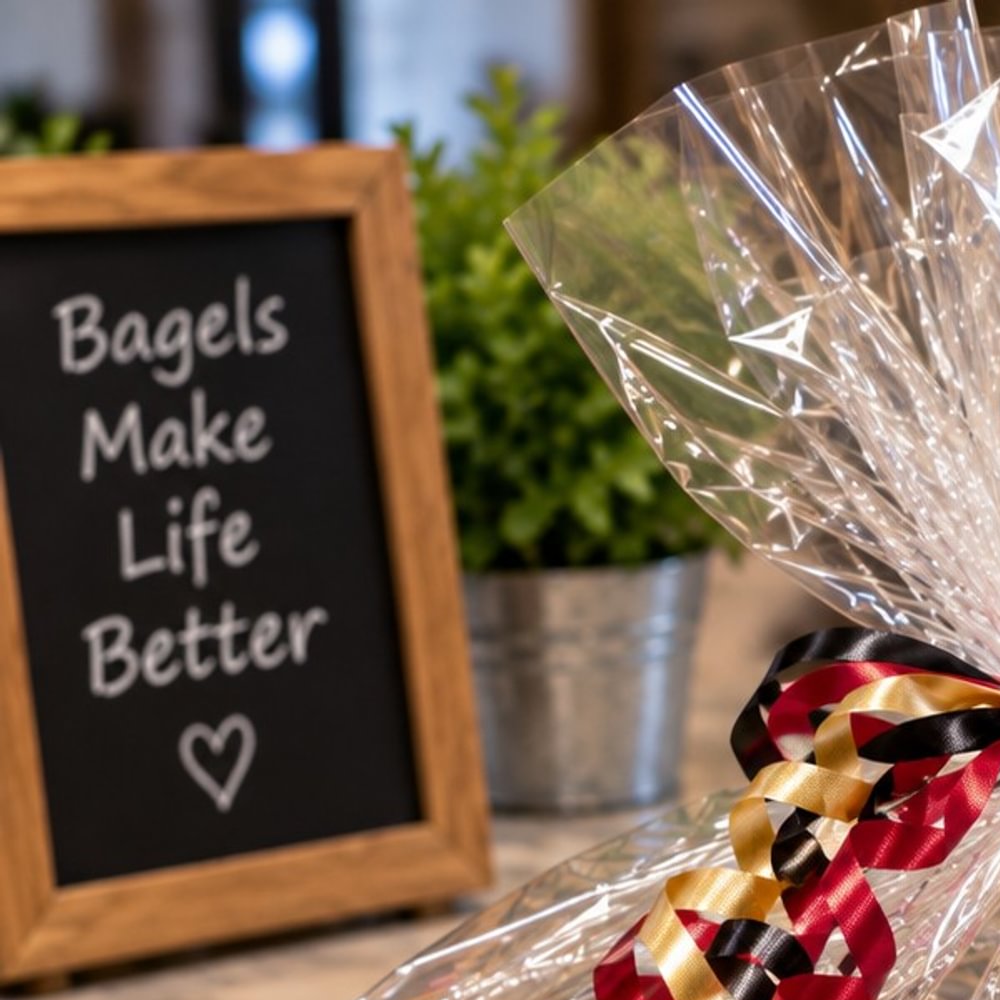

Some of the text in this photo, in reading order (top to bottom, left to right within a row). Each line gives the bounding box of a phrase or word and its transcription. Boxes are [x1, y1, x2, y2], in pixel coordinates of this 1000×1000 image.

[53, 275, 288, 387] Bagels
[81, 389, 271, 481] Make
[119, 486, 259, 588] Life
[82, 602, 327, 698] Better
